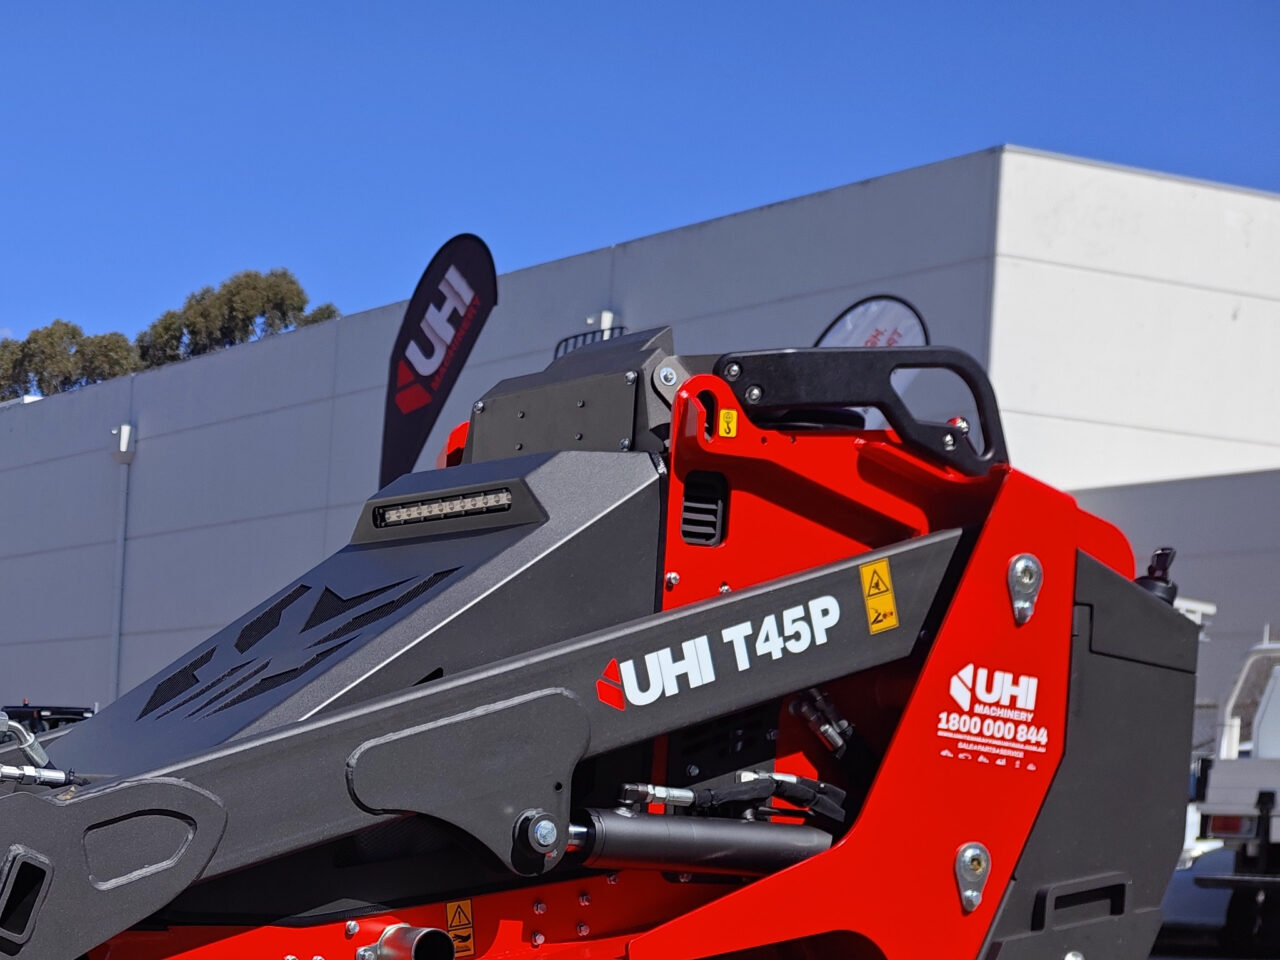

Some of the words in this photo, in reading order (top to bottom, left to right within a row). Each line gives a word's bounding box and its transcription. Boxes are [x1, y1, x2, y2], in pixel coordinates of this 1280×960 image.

[405, 264, 476, 377] UHI
[431, 294, 481, 392] MACHINERY
[620, 634, 716, 706] UHI
[721, 595, 841, 672] T45P
[973, 704, 1035, 723] MACHINERY
[975, 667, 1039, 710] UHI
[937, 712, 981, 734] 1800
[982, 718, 1015, 740] 000
[1016, 724, 1048, 745] 844
